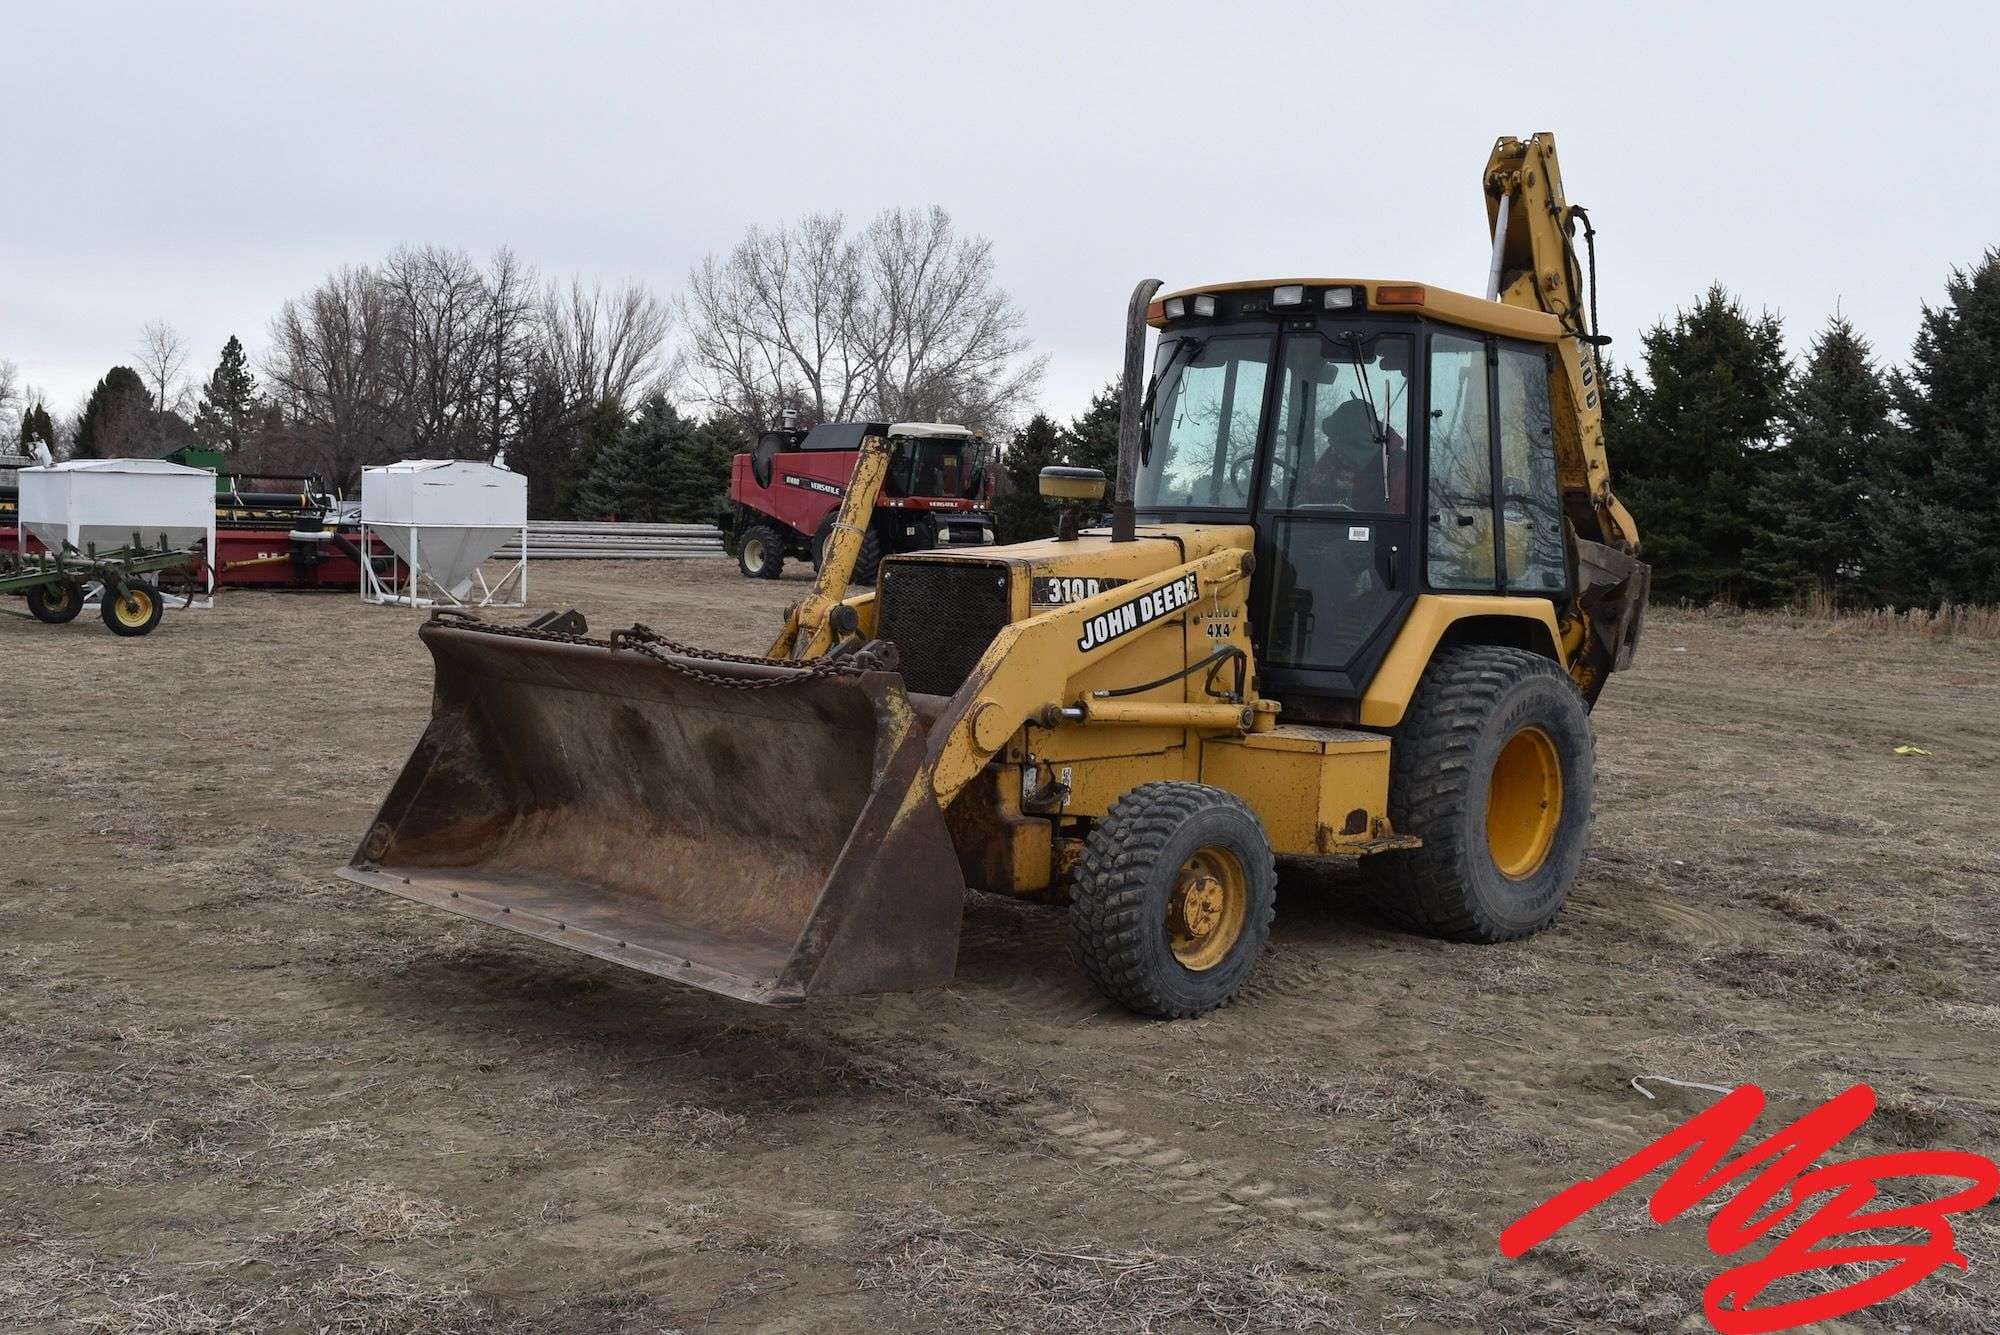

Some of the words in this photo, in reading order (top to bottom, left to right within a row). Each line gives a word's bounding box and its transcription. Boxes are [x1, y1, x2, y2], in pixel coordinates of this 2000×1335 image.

[1048, 578, 1100, 603] 310D
[1080, 603, 1137, 650] JOHN
[1140, 575, 1197, 622] DEERE
[1207, 623, 1230, 638] 4X4
